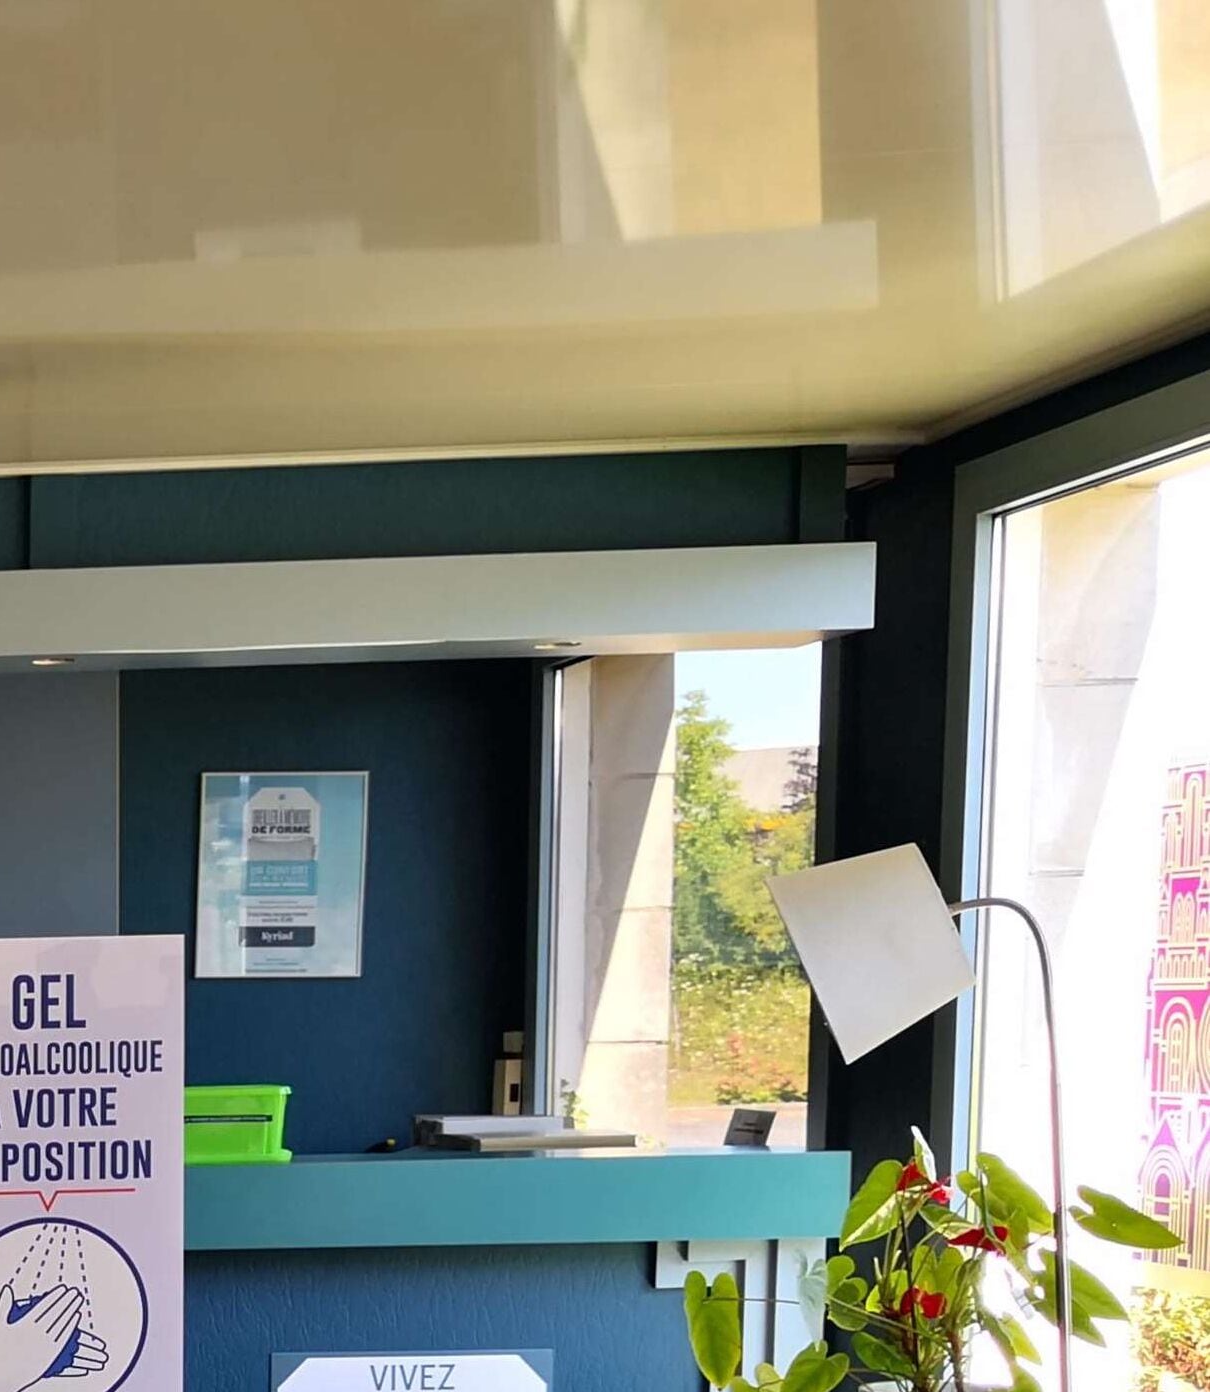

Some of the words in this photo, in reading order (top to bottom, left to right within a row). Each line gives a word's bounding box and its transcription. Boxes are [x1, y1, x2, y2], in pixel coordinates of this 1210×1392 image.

[11, 973, 87, 1030] GEL
[12, 1087, 117, 1128] VOTRE
[369, 1363, 456, 1391] VIVEZ
